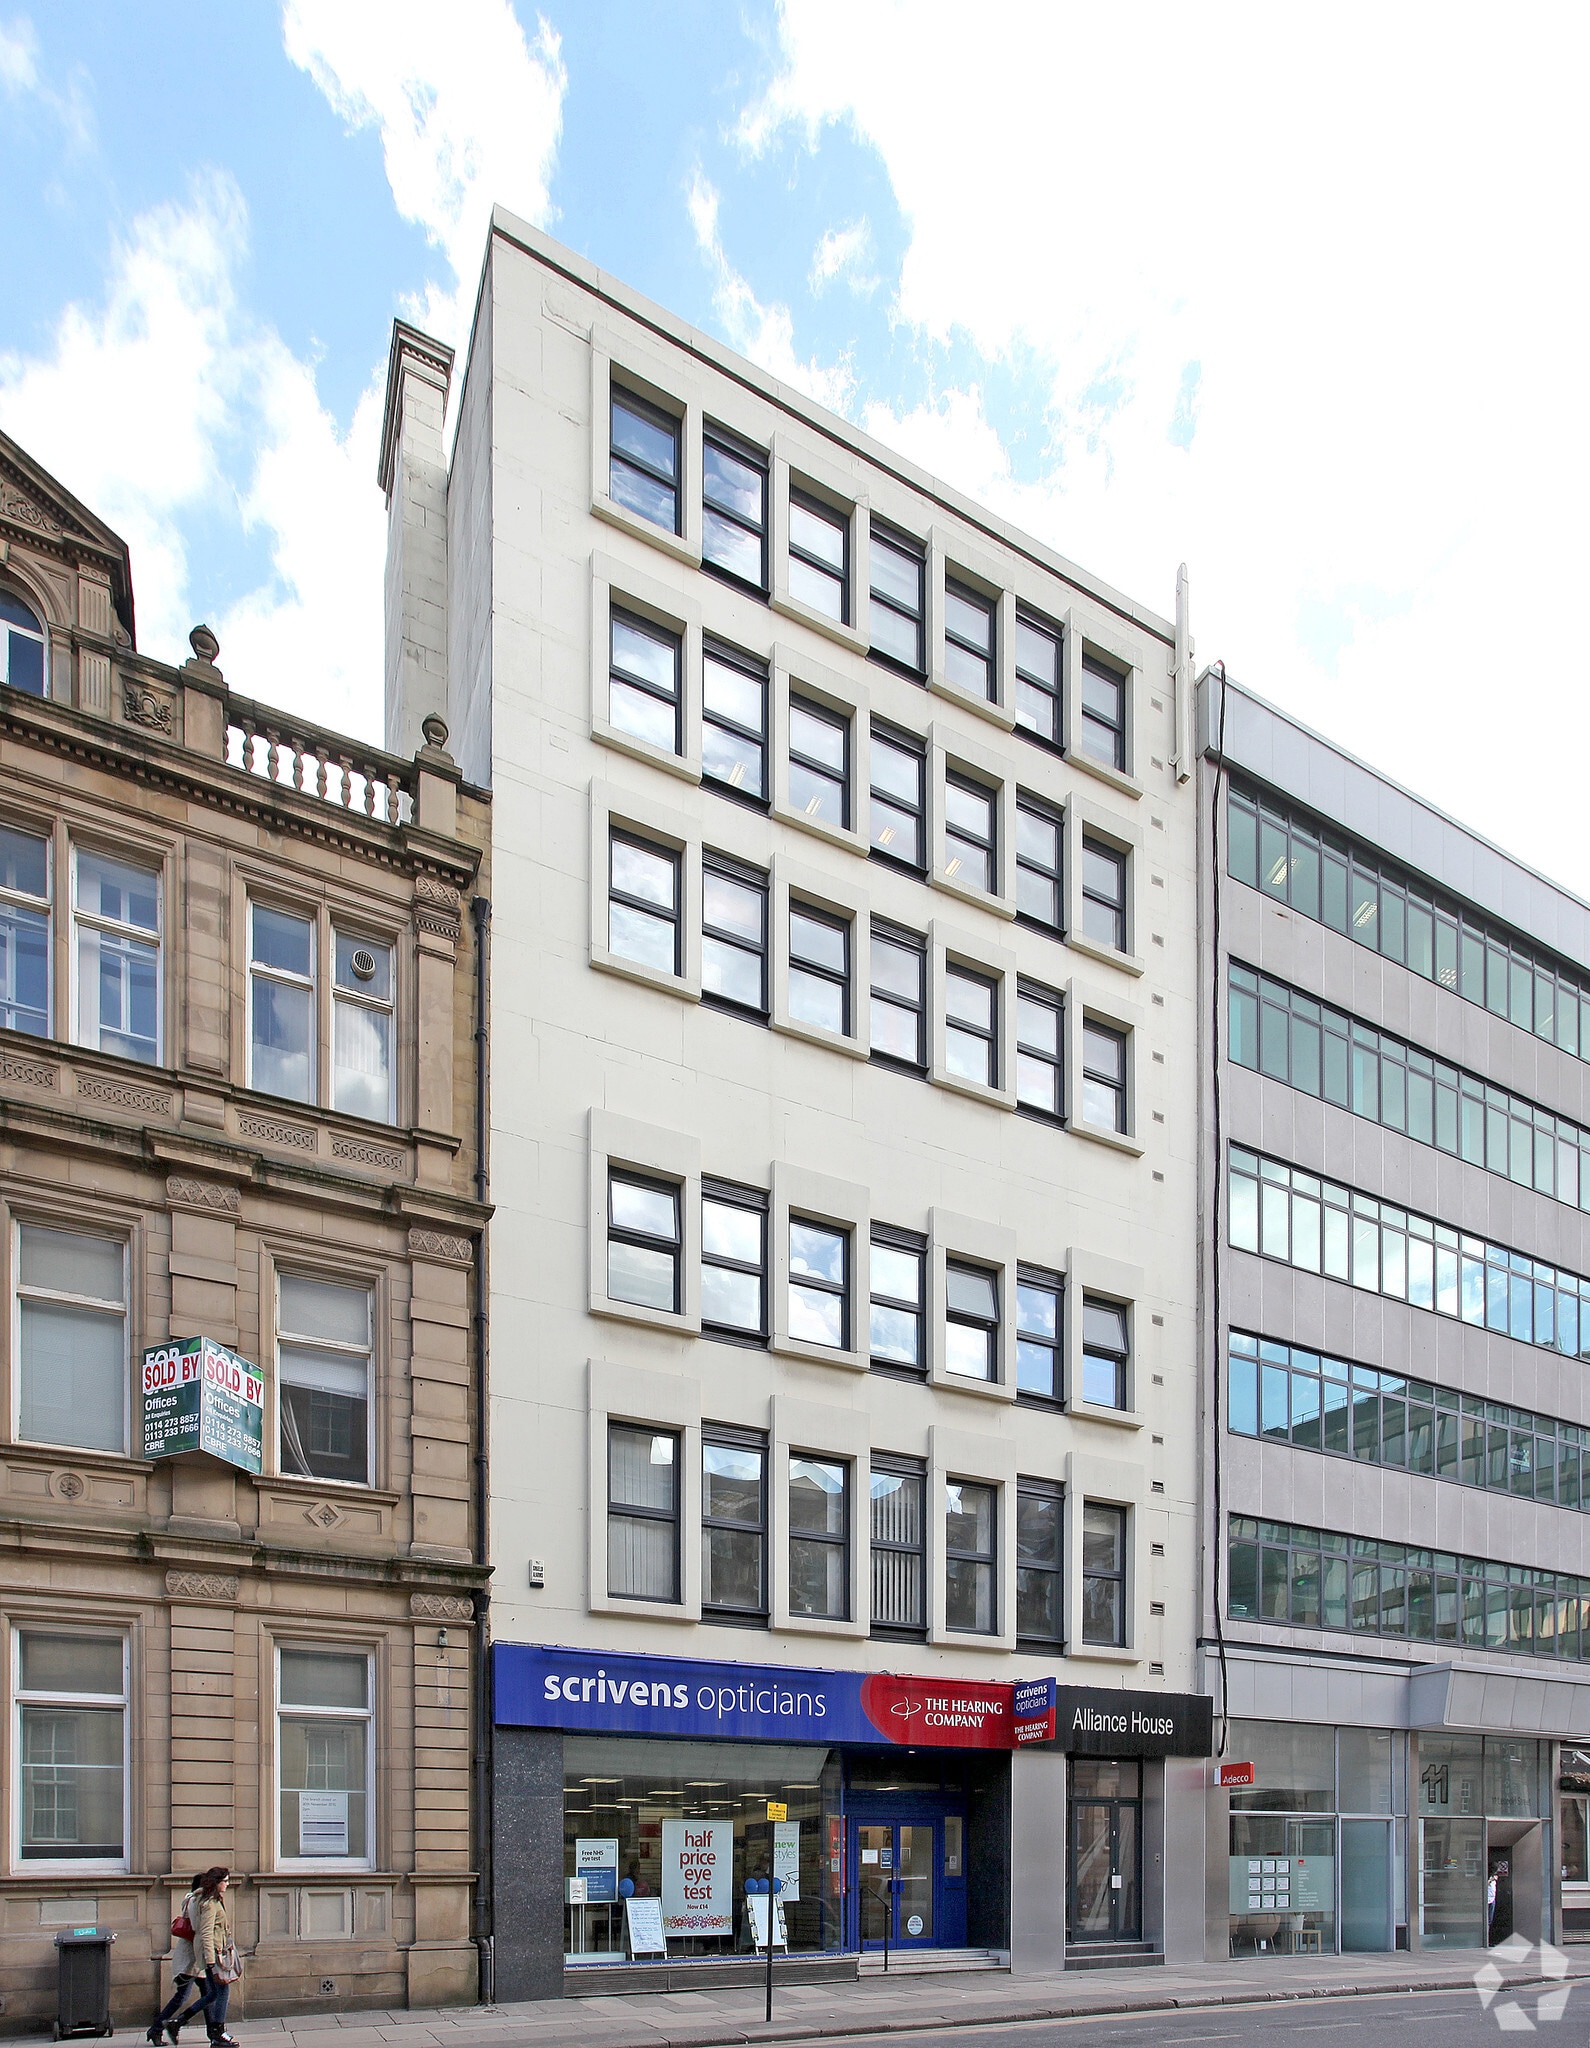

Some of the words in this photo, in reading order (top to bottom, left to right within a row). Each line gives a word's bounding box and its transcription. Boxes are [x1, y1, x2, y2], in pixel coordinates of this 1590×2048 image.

[145, 1361, 176, 1389] SOLD
[182, 1353, 199, 1380] BY
[207, 1355, 240, 1392] SOLD
[247, 1377, 262, 1404] BY
[145, 1396, 177, 1411] Offices
[206, 1392, 240, 1418] Offices
[145, 1420, 162, 1432] 0114
[164, 1417, 178, 1427] 273
[179, 1413, 199, 1425] 8857
[151, 1410, 171, 1419] Enquiries
[145, 1430, 162, 1441] 0113
[164, 1427, 178, 1437] 233
[179, 1423, 199, 1434] 7666
[205, 1415, 225, 1431] 0114
[227, 1426, 242, 1439] 273
[243, 1434, 261, 1448] 8857
[205, 1425, 225, 1440] 0113
[227, 1435, 242, 1448] 233
[145, 1440, 165, 1451] CBRE
[204, 1435, 227, 1452] CBRE
[543, 1669, 689, 1710] scrivens
[697, 1682, 827, 1719] opticians
[1015, 1682, 1048, 1700] scrivens
[925, 1697, 948, 1712] THE
[950, 1698, 1003, 1715] HEARING
[1015, 1695, 1047, 1713] opticians
[925, 1712, 985, 1728] COMPANY
[1014, 1725, 1024, 1734] THE
[1024, 1721, 1048, 1734] HEARING
[1072, 1707, 1127, 1732] Alliance
[1131, 1712, 1174, 1735] House
[1017, 1729, 1044, 1741] COMPANY
[1222, 1774, 1249, 1784] Adecco
[1421, 1764, 1448, 1804] 11
[684, 1829, 713, 1848] half
[679, 1849, 716, 1871] price
[774, 1848, 796, 1861] styles
[684, 1867, 712, 1884] eye
[683, 1884, 712, 1900] test
